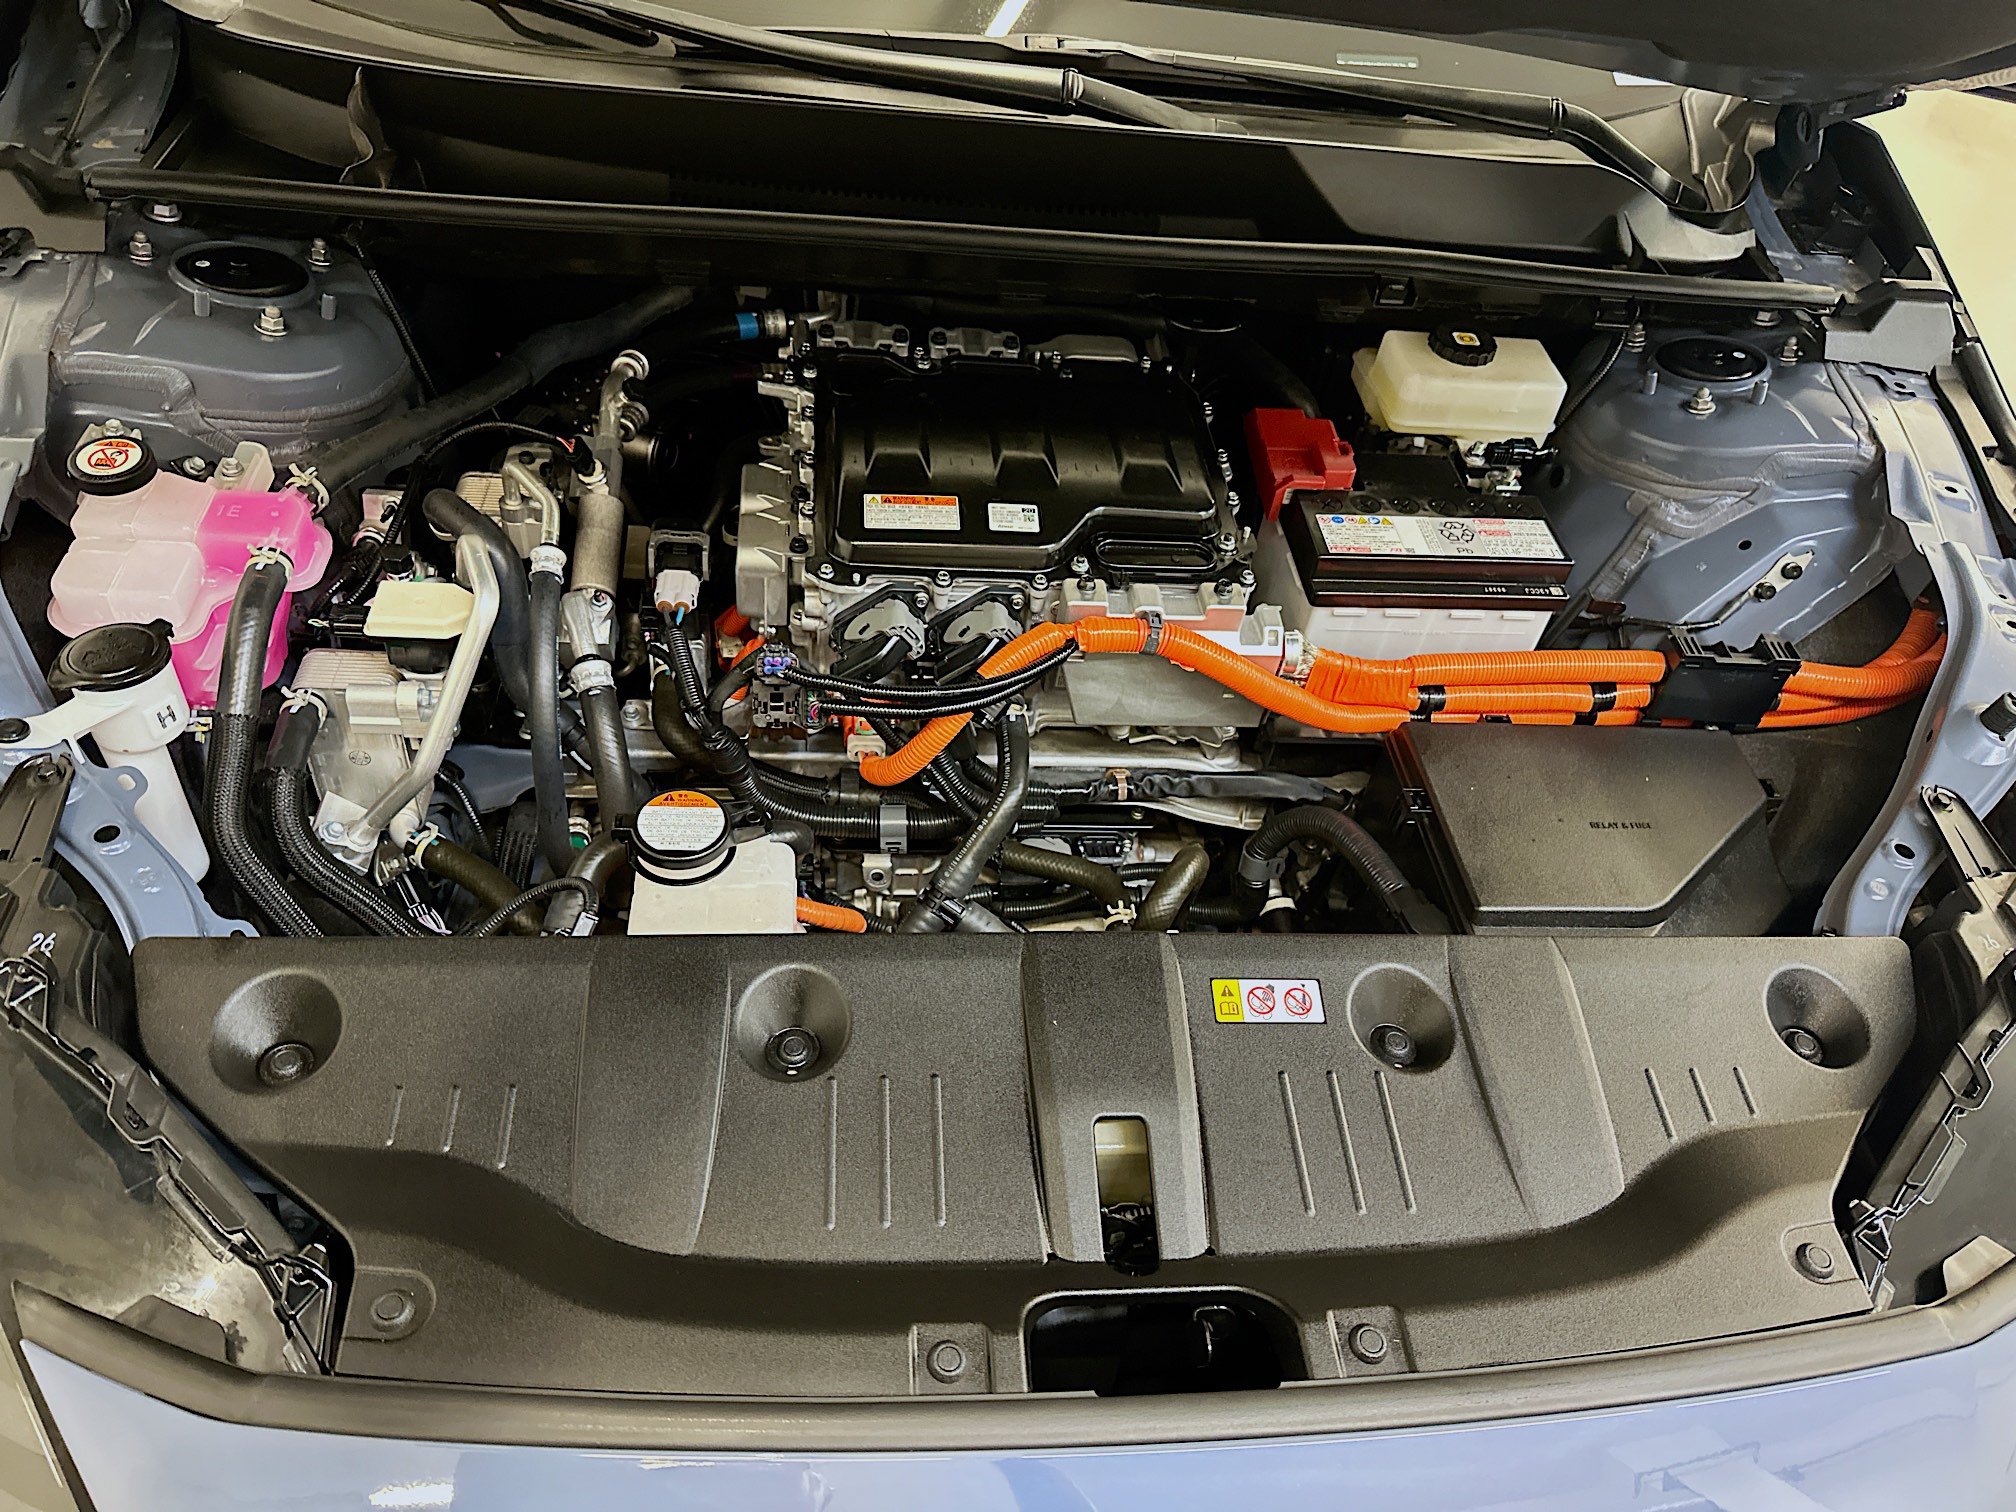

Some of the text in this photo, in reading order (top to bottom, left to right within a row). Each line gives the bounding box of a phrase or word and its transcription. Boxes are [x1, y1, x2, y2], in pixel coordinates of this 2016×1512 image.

[157, 704, 177, 730] H
[1589, 821, 1618, 829] RELAY
[28, 932, 57, 958] 26
